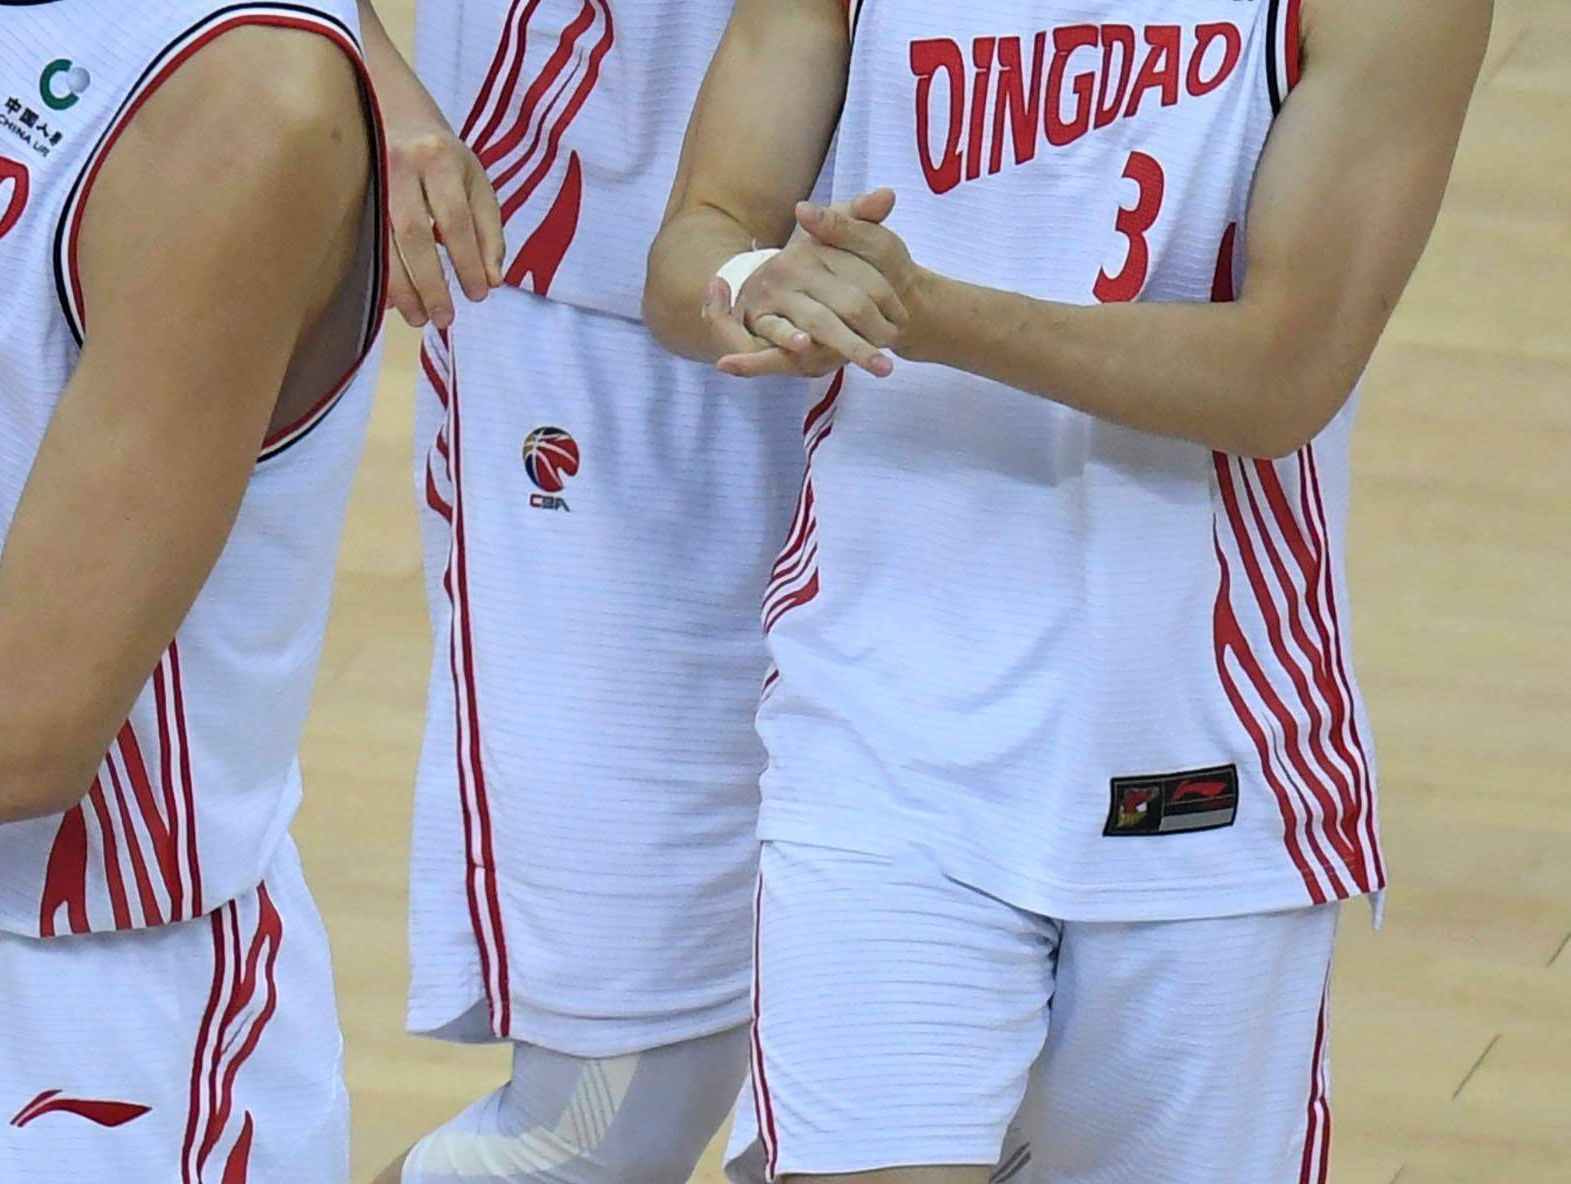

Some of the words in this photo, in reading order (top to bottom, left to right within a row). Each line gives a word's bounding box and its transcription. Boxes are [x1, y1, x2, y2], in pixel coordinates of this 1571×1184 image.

[909, 22, 1242, 195] QINGDAO
[1092, 150, 1165, 303] 3
[529, 493, 571, 512] CBA
